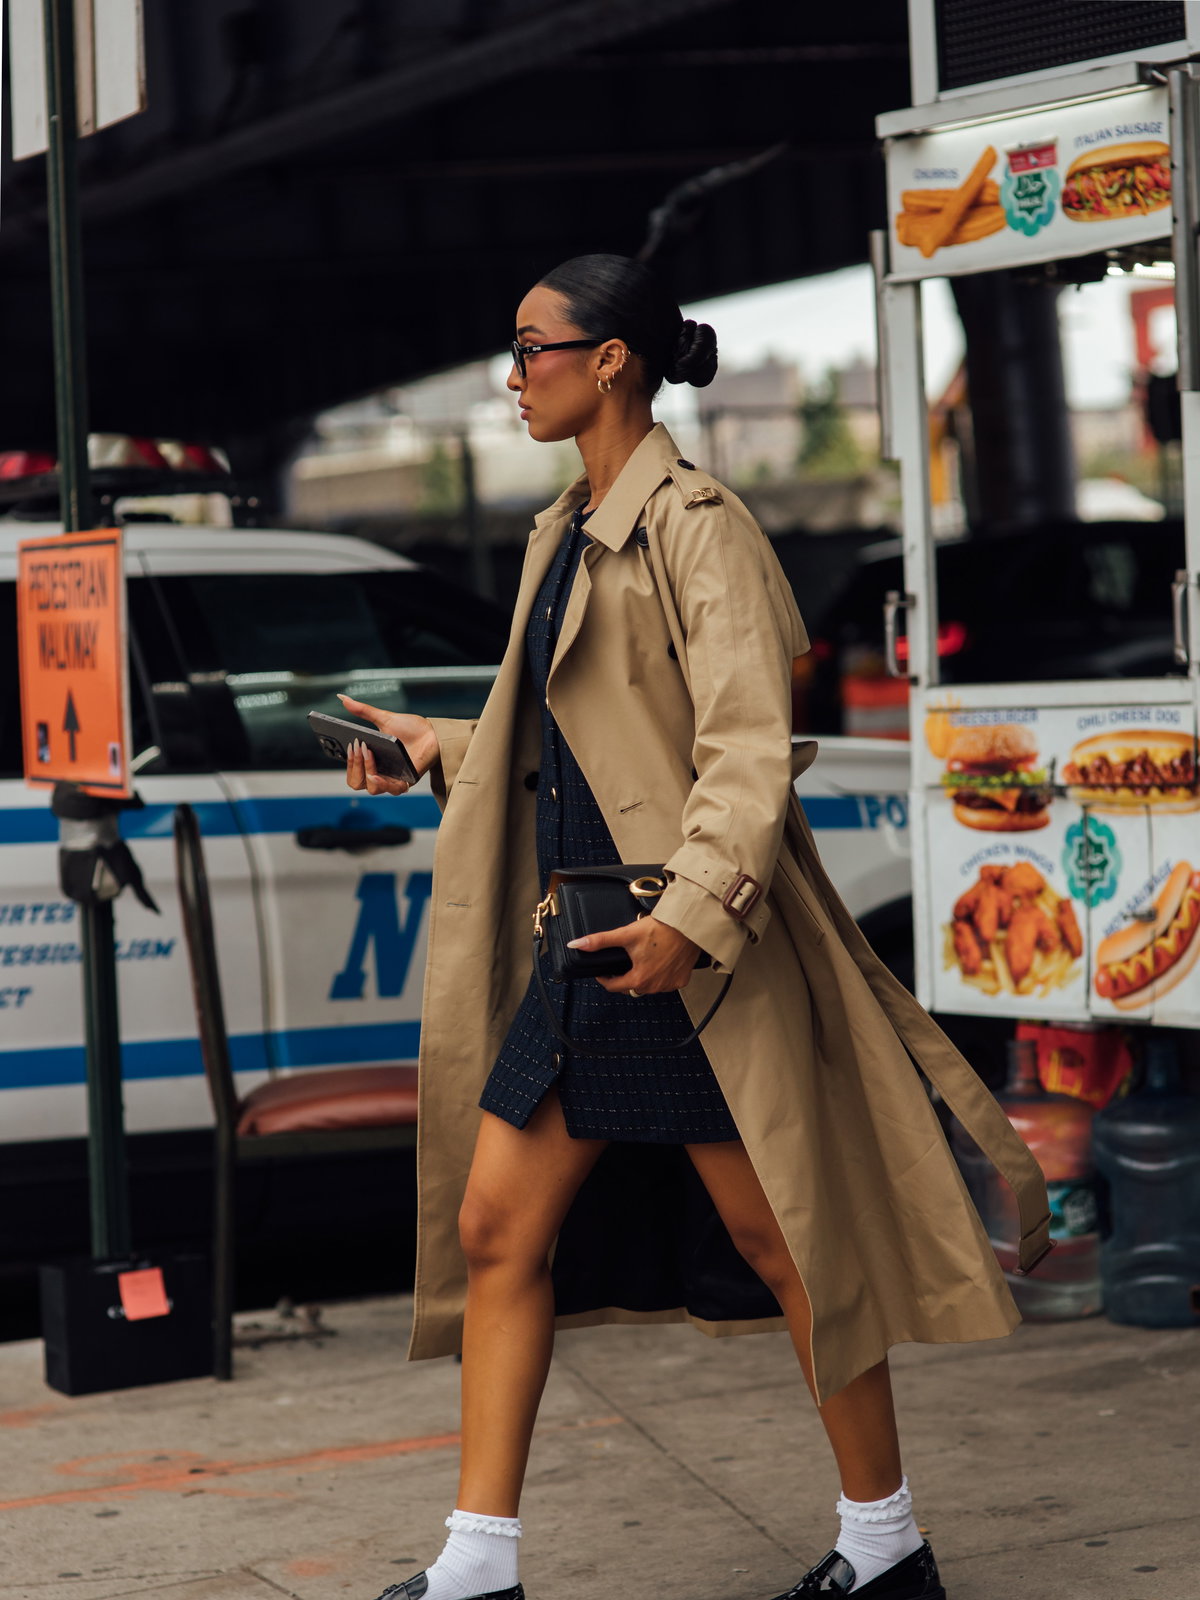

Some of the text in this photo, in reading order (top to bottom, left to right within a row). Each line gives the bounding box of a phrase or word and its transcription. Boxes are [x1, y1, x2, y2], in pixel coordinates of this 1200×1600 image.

[1074, 121, 1162, 148] ITALIAN SAUSAGE
[28, 557, 109, 611] PEDESTRIAN
[37, 620, 99, 671] WALKWAY
[949, 708, 1039, 728] CHEESEBURGER
[1077, 709, 1181, 730] CHILI CHEESE DOG
[960, 843, 1055, 876] CHICKEN WINGS
